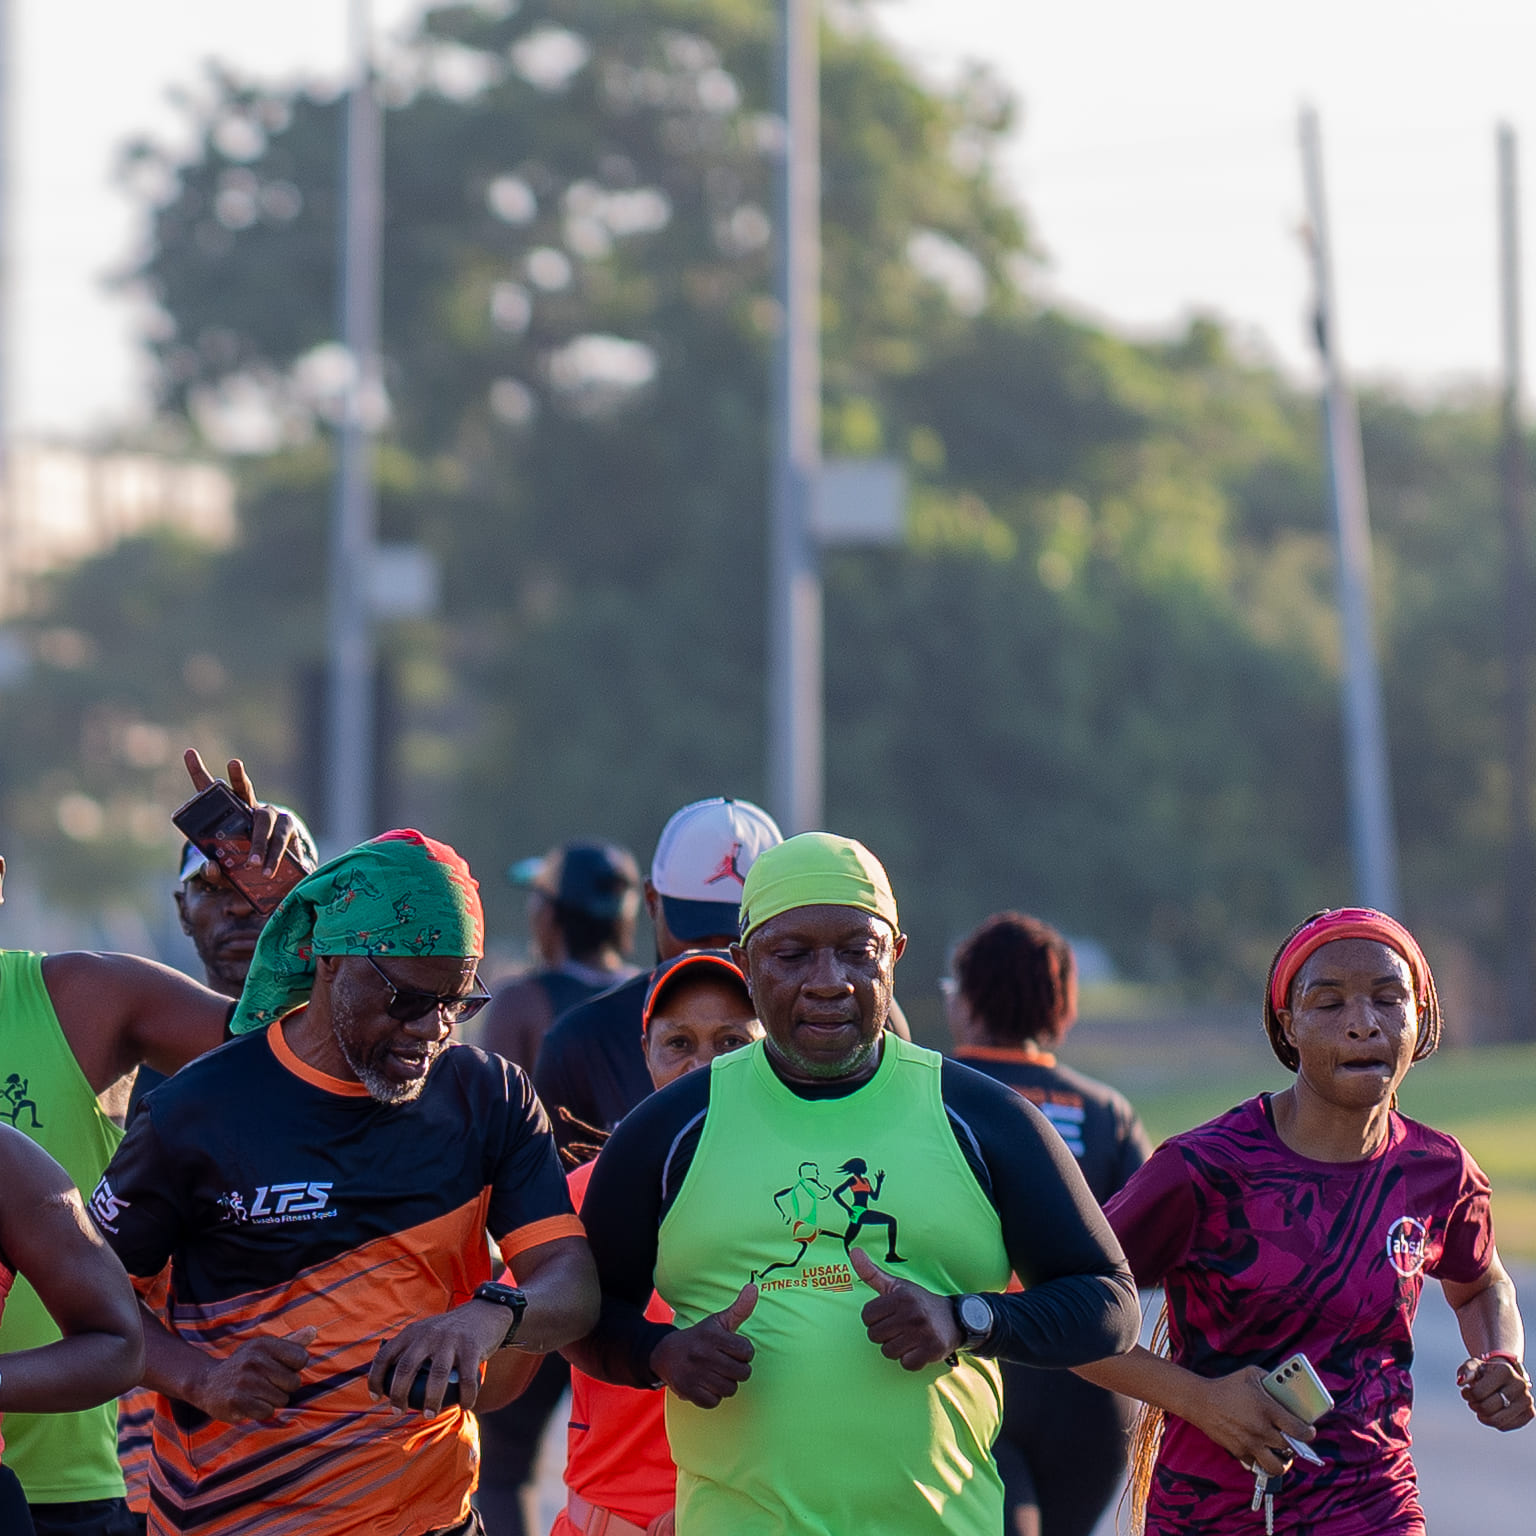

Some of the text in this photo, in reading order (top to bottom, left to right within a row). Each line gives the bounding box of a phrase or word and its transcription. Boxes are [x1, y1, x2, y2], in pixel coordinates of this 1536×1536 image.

[250, 1182, 333, 1216] LFS
[802, 1264, 849, 1278] LUSAKA
[761, 1274, 851, 1292] FITNESS SQUAD
